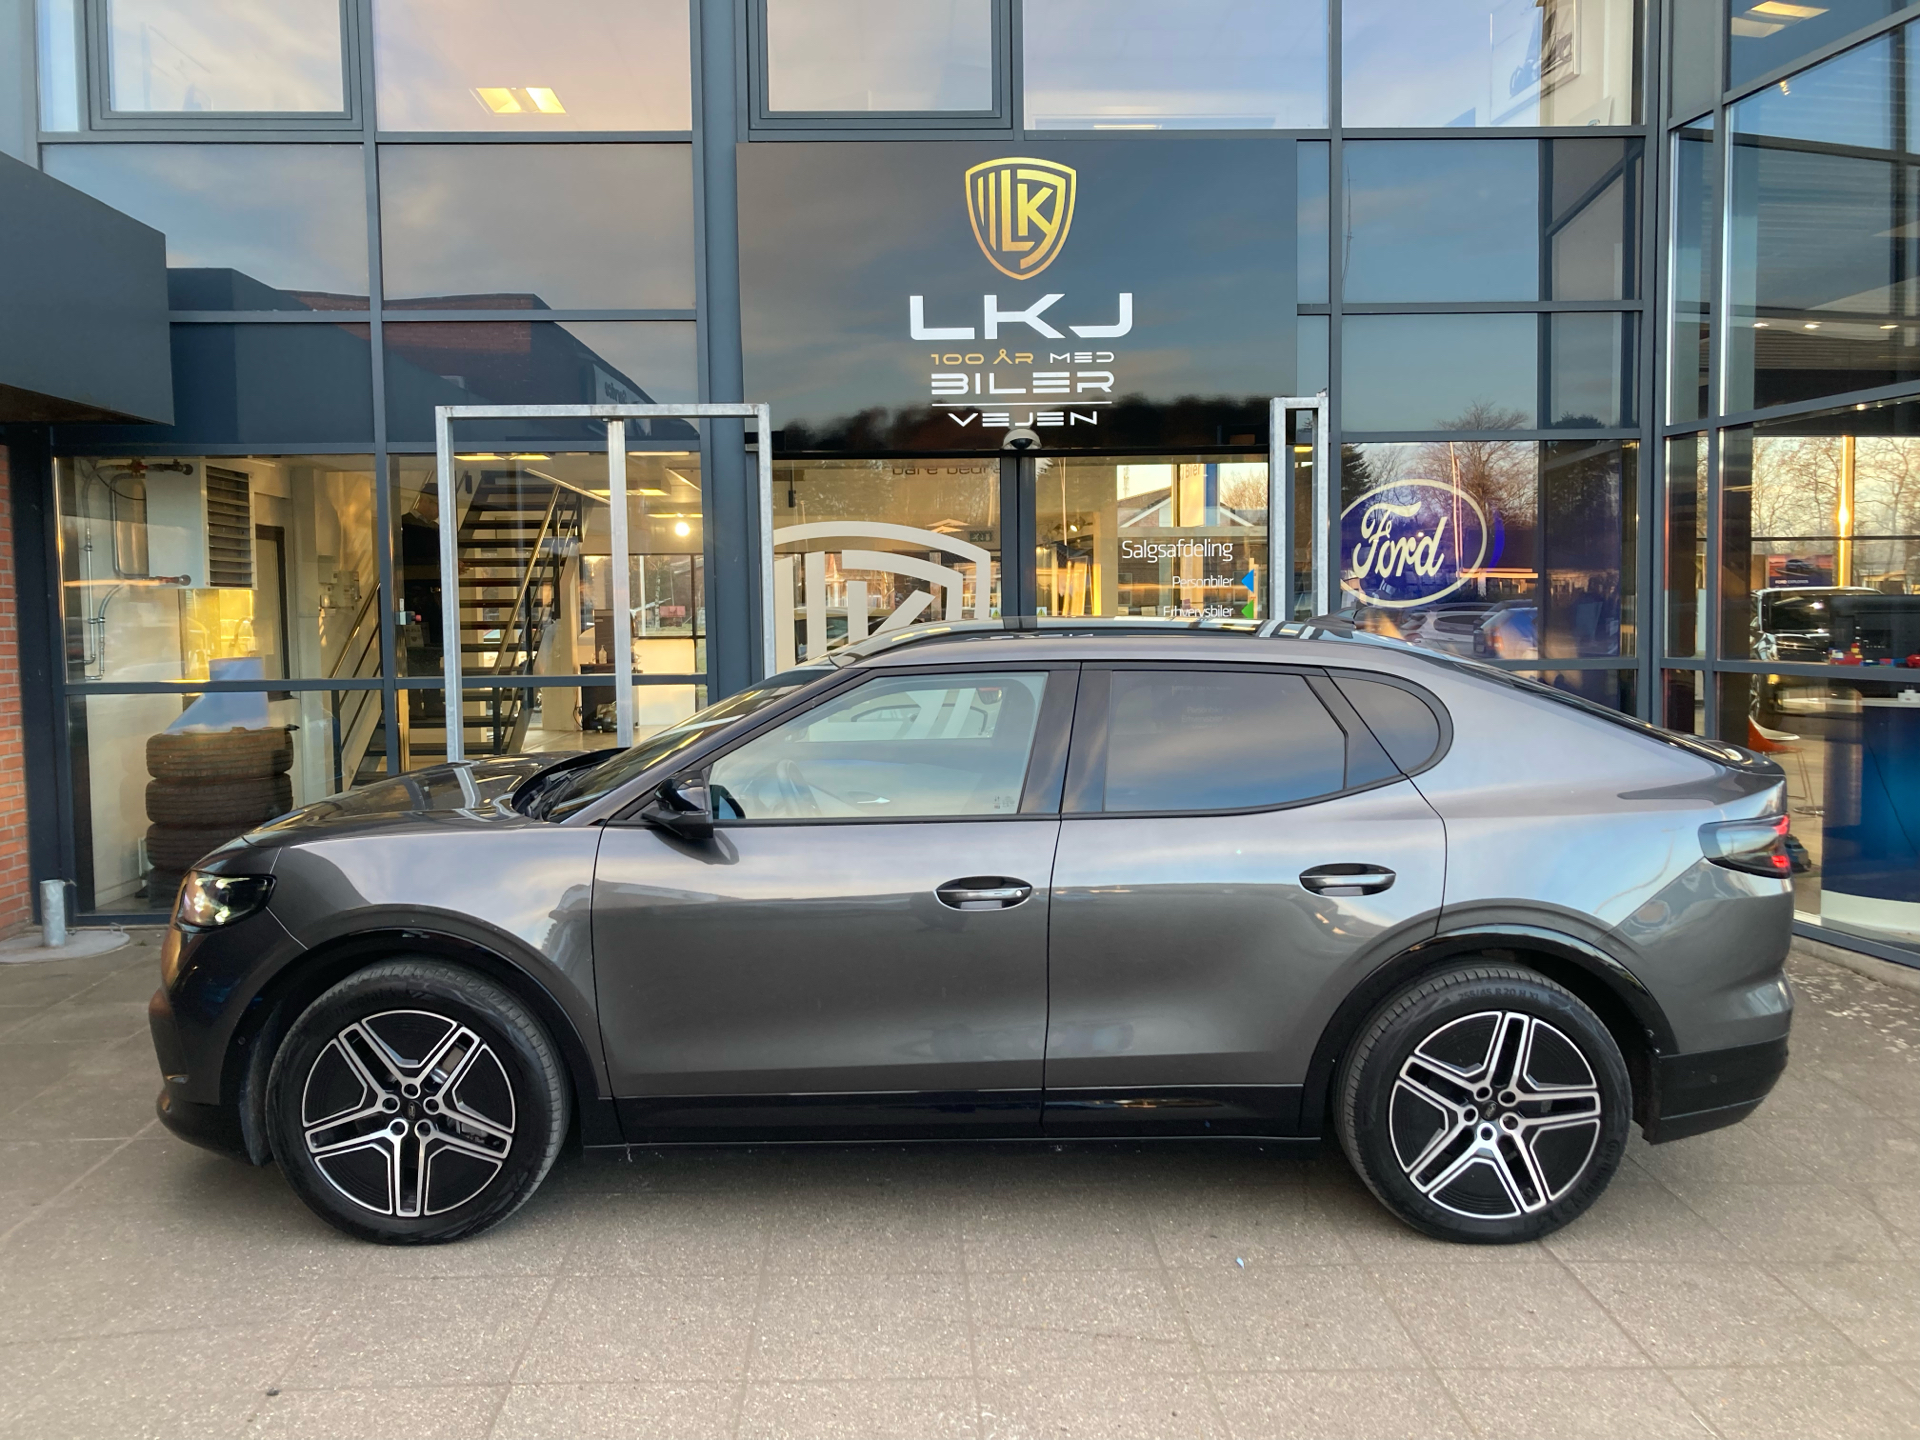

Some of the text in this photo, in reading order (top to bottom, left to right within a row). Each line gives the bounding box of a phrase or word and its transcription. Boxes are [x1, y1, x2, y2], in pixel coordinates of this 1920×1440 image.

[909, 292, 1133, 341] LKJ
[931, 348, 1115, 365] 100 ÅR MED
[931, 370, 1115, 395] BILER
[948, 410, 1098, 427] VEJEN
[1121, 538, 1234, 563] Salgsafdeling
[1352, 501, 1448, 579] Ford
[1172, 574, 1234, 588] Personbiler
